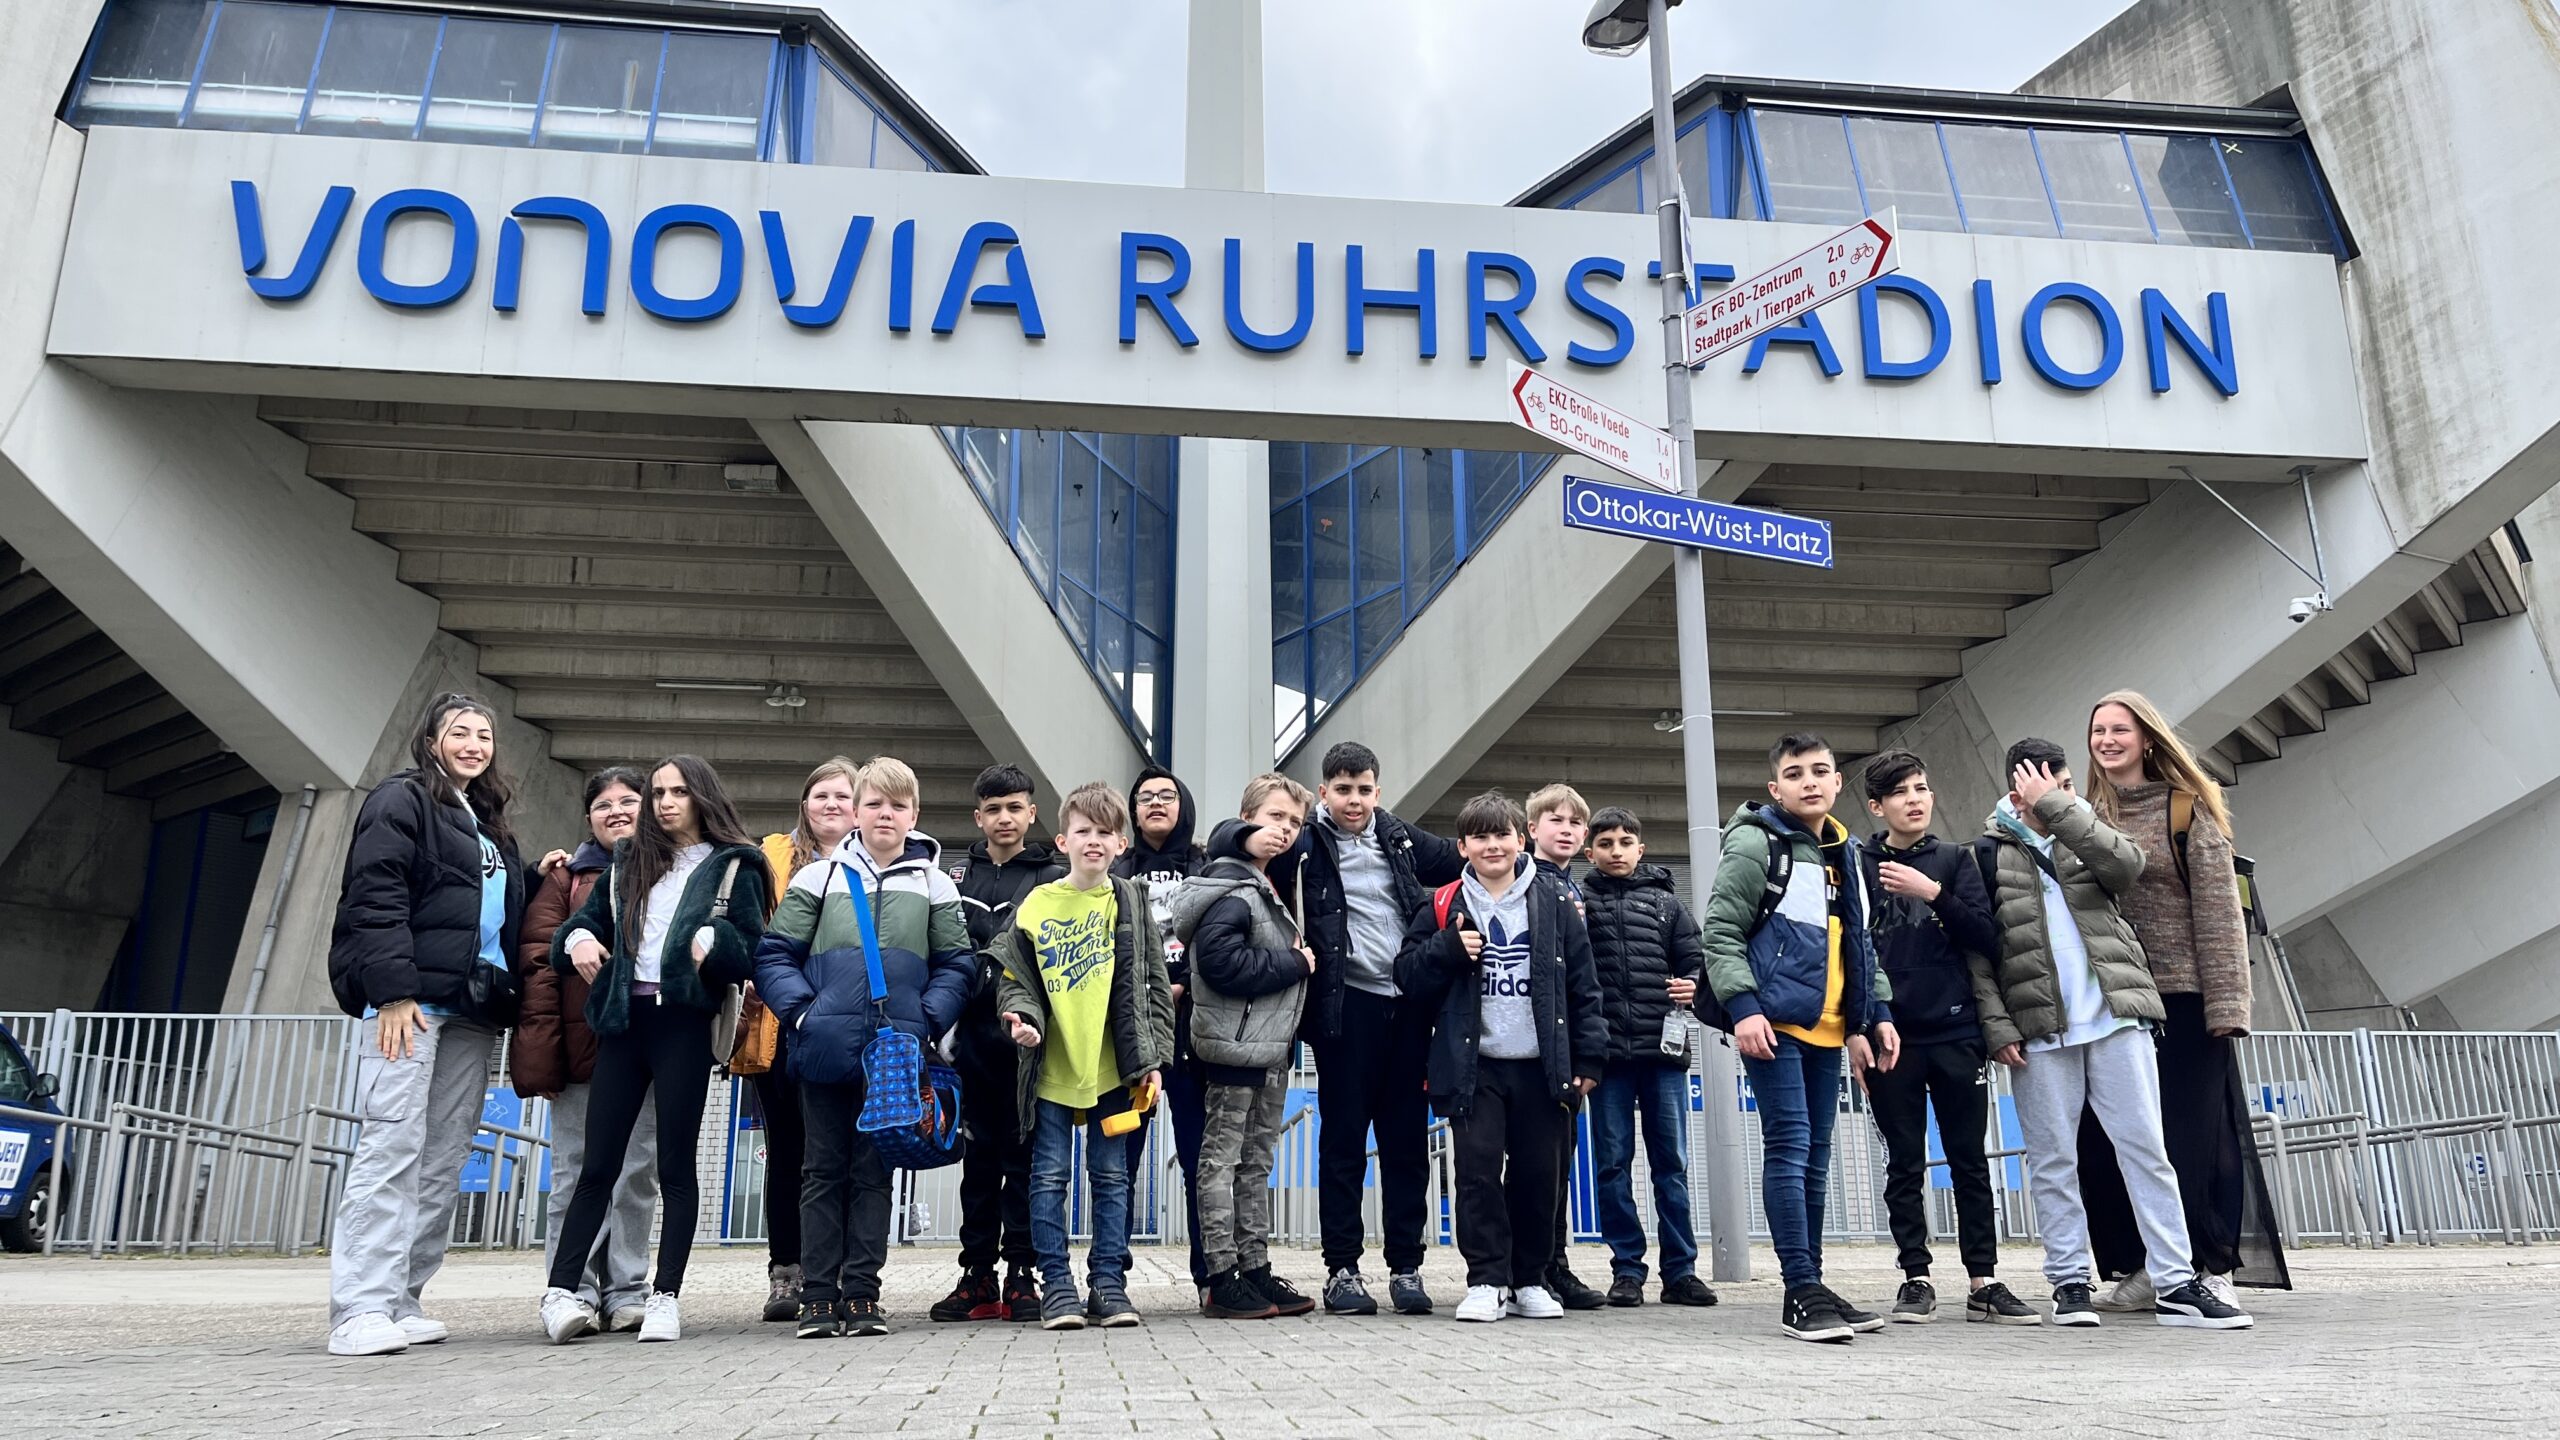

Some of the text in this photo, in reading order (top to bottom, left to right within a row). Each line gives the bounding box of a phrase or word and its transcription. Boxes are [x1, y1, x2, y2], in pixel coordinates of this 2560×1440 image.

[230, 179, 1046, 340] VONOVIA
[1729, 266, 1803, 312] BO-Zentrum
[1695, 314, 1753, 354] Stadtpark
[1763, 283, 1816, 320] Tierpark
[1548, 387, 1568, 412] EKZ
[1570, 399, 1599, 425] Große
[1601, 412, 1631, 439] Voede
[1549, 413, 1630, 463] BO-Grumme
[1576, 489, 1823, 556] Ottokar-Wüst-Platz
[1481, 972, 1532, 997] dida
